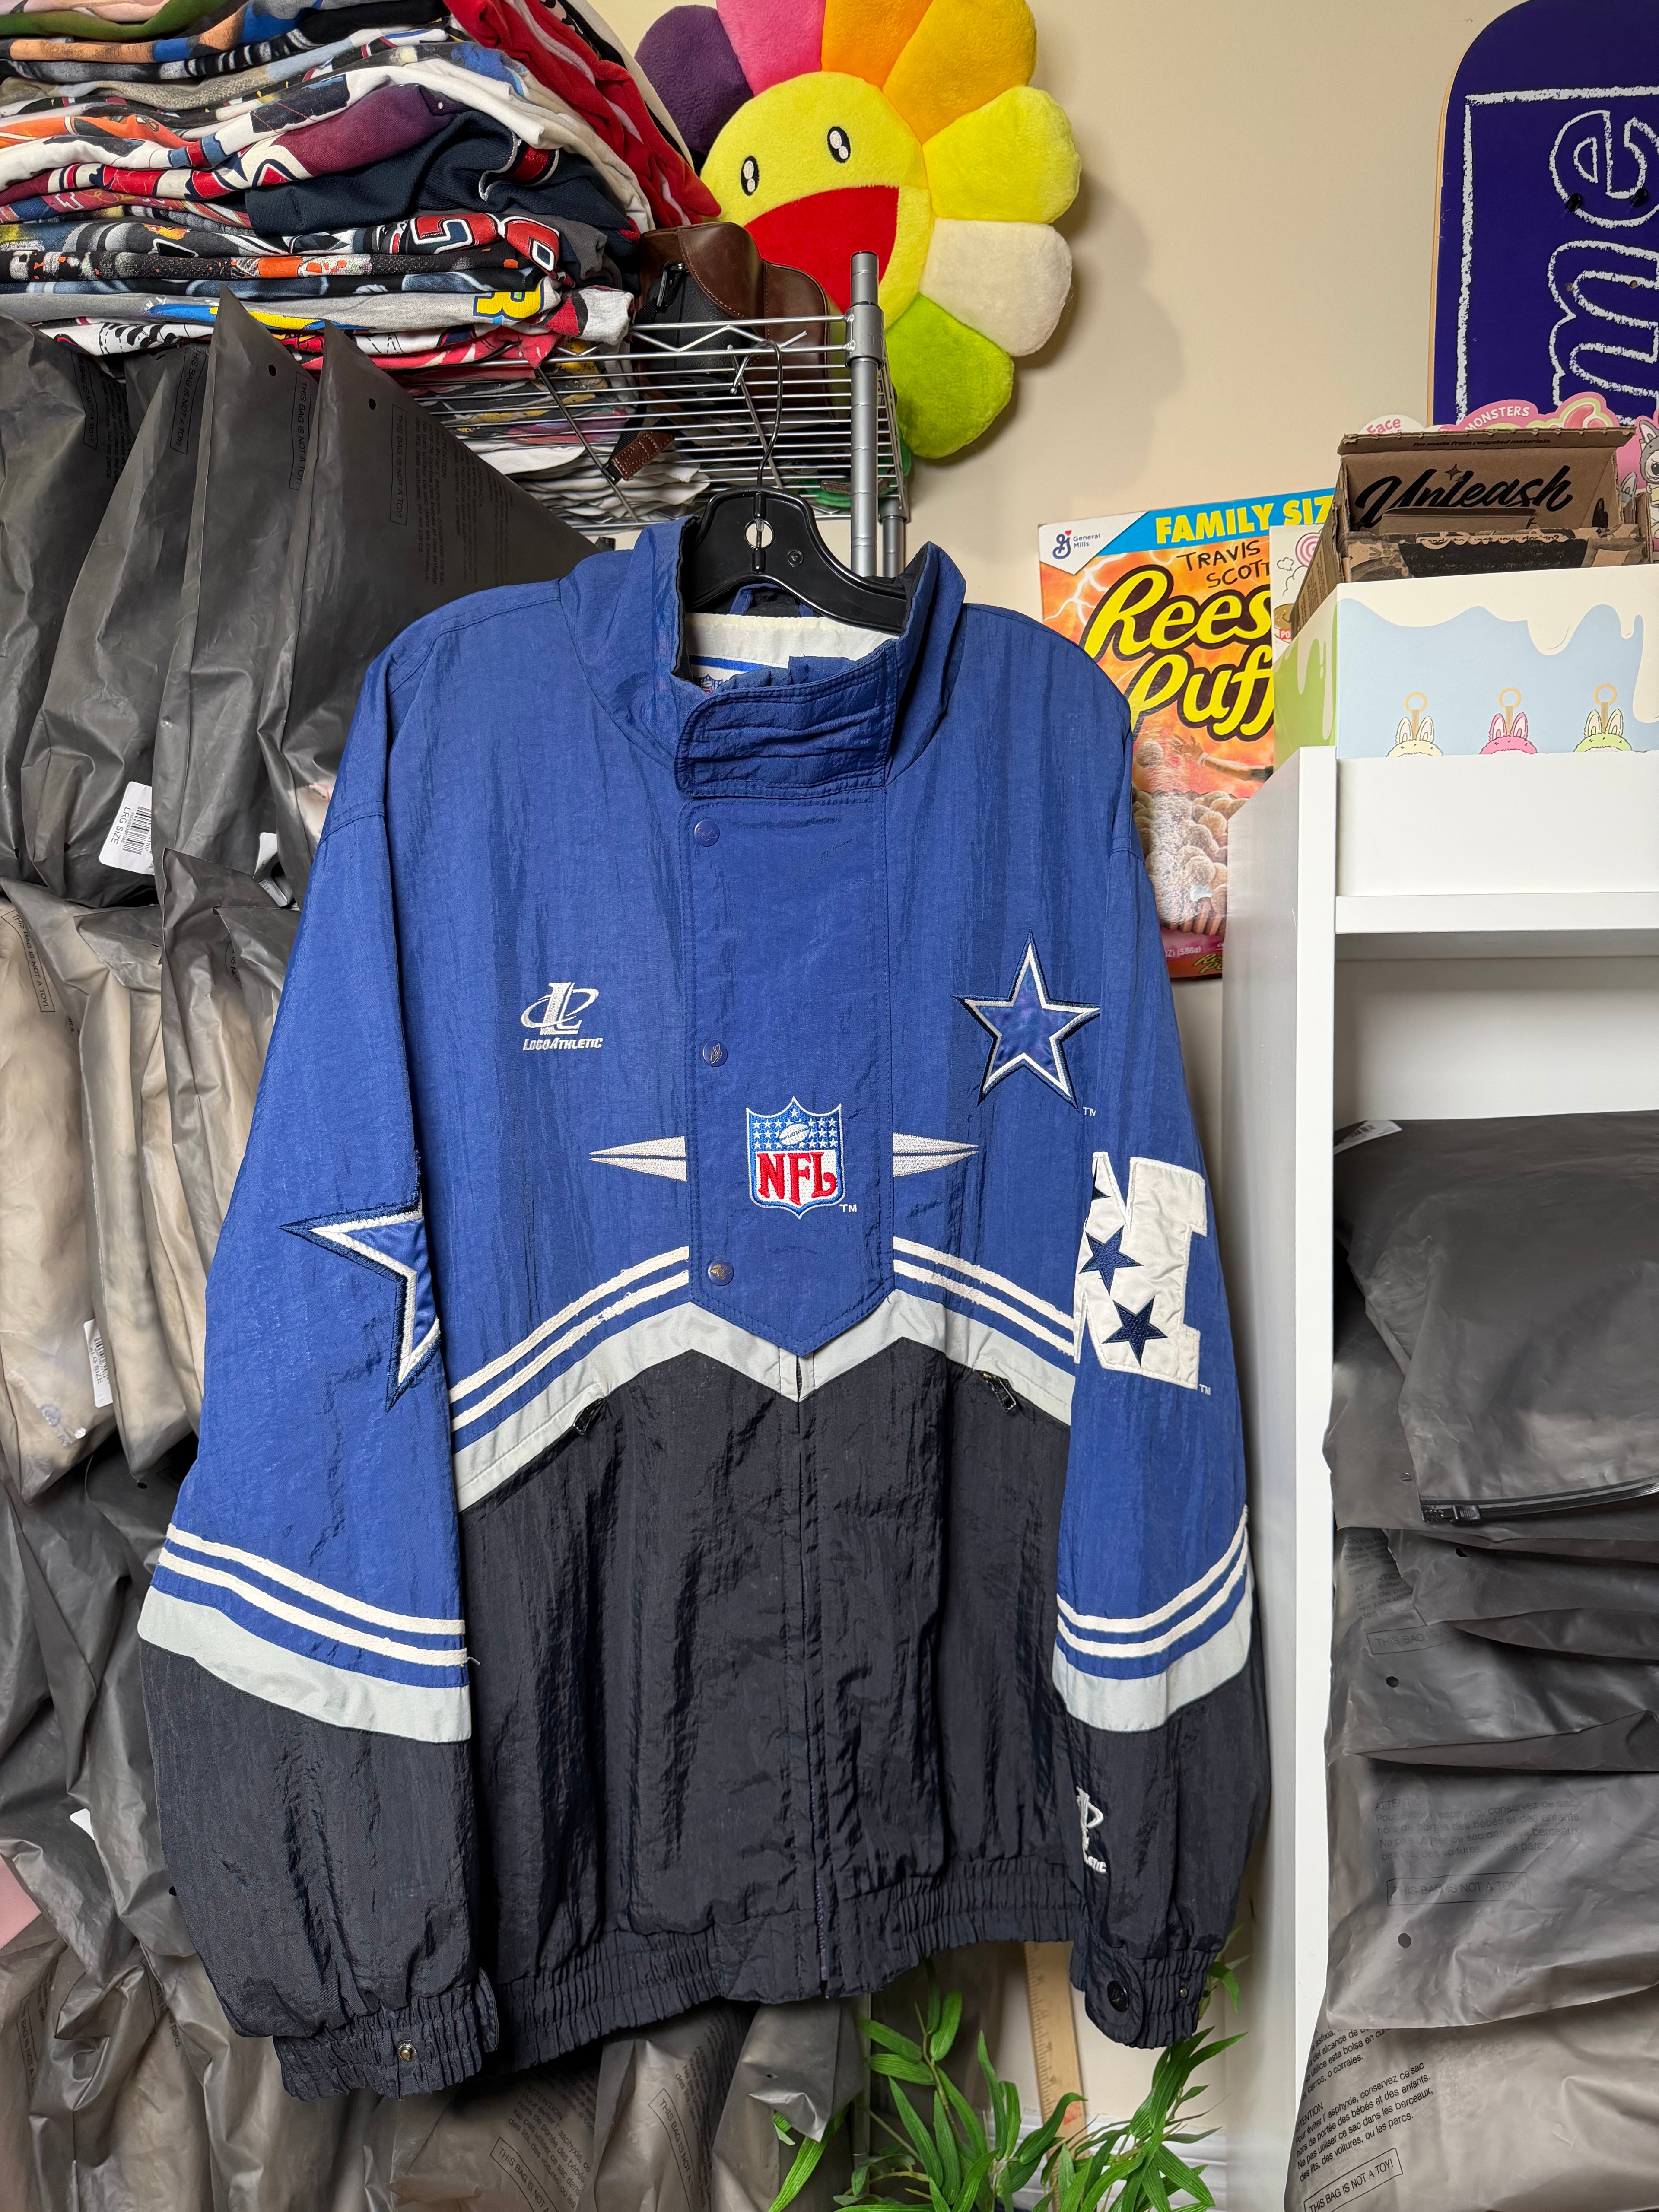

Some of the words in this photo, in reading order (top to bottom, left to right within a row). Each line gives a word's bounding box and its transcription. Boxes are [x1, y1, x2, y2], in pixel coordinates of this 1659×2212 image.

[186, 370, 195, 387] BAG
[184, 388, 190, 398] IS
[1465, 406, 1530, 431] MONSTERS
[176, 426, 185, 446] TOY!
[297, 426, 305, 434] IS
[1355, 465, 1573, 528] Unleash
[395, 499, 404, 519] TOY!
[1156, 503, 1274, 543] FAMILY
[1283, 495, 1334, 525] SIZ
[1177, 540, 1261, 571] TRAVIS
[1207, 559, 1270, 588] SCOTT
[1128, 644, 1274, 736] Puff
[119, 807, 131, 825] LRG
[111, 825, 124, 845] SIZE
[12, 913, 25, 929] THIS
[23, 931, 32, 949] BAG
[29, 951, 35, 959] IS
[31, 960, 41, 979] NOT
[39, 988, 50, 1007] TOY!
[757, 1152, 837, 1206] NFL
[839, 1203, 857, 1213] TM
[94, 1365, 104, 1384] SIZE
[1199, 1383, 1211, 1395] TM
[1361, 1610, 1378, 1620] des
[1375, 1636, 1400, 1646] THIS
[1402, 1633, 1425, 1644] BAG
[1488, 1802, 1538, 1815] conservez
[1541, 1800, 1553, 1808] ce
[1507, 1815, 1517, 1824] et
[1466, 1832, 1484, 1841] sac
[1520, 1840, 1553, 1852] parcs.
[1460, 1882, 1482, 1893] NOT
[1485, 1881, 1494, 1892] A
[170, 2024, 181, 2050] parcs.
[1313, 2050, 1322, 2062] del
[1322, 2036, 1348, 2055] alcance
[1348, 2029, 1359, 2039] de
[1328, 2051, 1342, 2064] esta
[1342, 2041, 1364, 2055] bolsa
[1365, 2034, 1375, 2044] en
[1307, 2075, 1328, 2093] carros,
[1333, 2054, 1364, 2074] corrales.
[1307, 2117, 1323, 2134] éviter
[1328, 2096, 1359, 2119] asphyxie,
[1360, 2076, 1398, 2099] conservez
[1399, 2071, 1410, 2080] ce
[1410, 2062, 1424, 2076] sac
[1296, 2145, 1308, 2158] hors
[1308, 2138, 1317, 2148] de
[1316, 2124, 1337, 2146] portée
[1337, 2113, 1351, 2127] des
[1351, 2100, 1374, 2119] bébés
[1375, 2094, 1383, 2106] et
[1383, 2087, 1400, 2101] des
[1401, 2073, 1431, 2094] enfants.
[658, 2098, 674, 2122] THIS
[671, 2120, 681, 2142] BAG
[677, 2142, 685, 2154] IS
[681, 2153, 691, 2174] NOT
[1297, 2158, 1306, 2170] Ne
[1306, 2149, 1318, 2167] pas
[1317, 2135, 1338, 2155] utiliser
[1338, 2129, 1348, 2140] ce
[1348, 2121, 1362, 2135] sac
[1362, 2111, 1382, 2128] dans
[1382, 2103, 1394, 2117] les
[1394, 2088, 1434, 2111] berceaux,
[558, 2129, 582, 2163] asphyxie,
[1299, 2169, 1310, 2183] des
[1309, 2161, 1322, 2175] lits,
[1321, 2152, 1334, 2167] des
[1334, 2135, 1364, 2158] voitures,
[1364, 2129, 1376, 2141] ou
[1376, 2120, 1387, 2135] les
[1388, 2112, 1414, 2131] parcs.
[508, 2118, 521, 2132] des
[531, 2143, 541, 2158] des
[559, 2185, 568, 2197] ou
[567, 2194, 577, 2209] les
[556, 2146, 569, 2162] des
[567, 2159, 587, 2183] bébés
[498, 2146, 516, 2167] THIS
[514, 2163, 528, 2183] BAG
[528, 2182, 534, 2192] IS
[533, 2189, 547, 2210] NOT
[550, 2154, 558, 2165] ce
[557, 2164, 568, 2179] sac
[566, 2177, 582, 2196] dans
[1308, 2195, 1326, 2212] THIS
[1325, 2188, 1342, 2206] BAG
[1342, 2182, 1350, 2195] IS
[1350, 2173, 1368, 2192] NOT
[1368, 2168, 1376, 2179] A
[1375, 2157, 1395, 2176] TOY!
